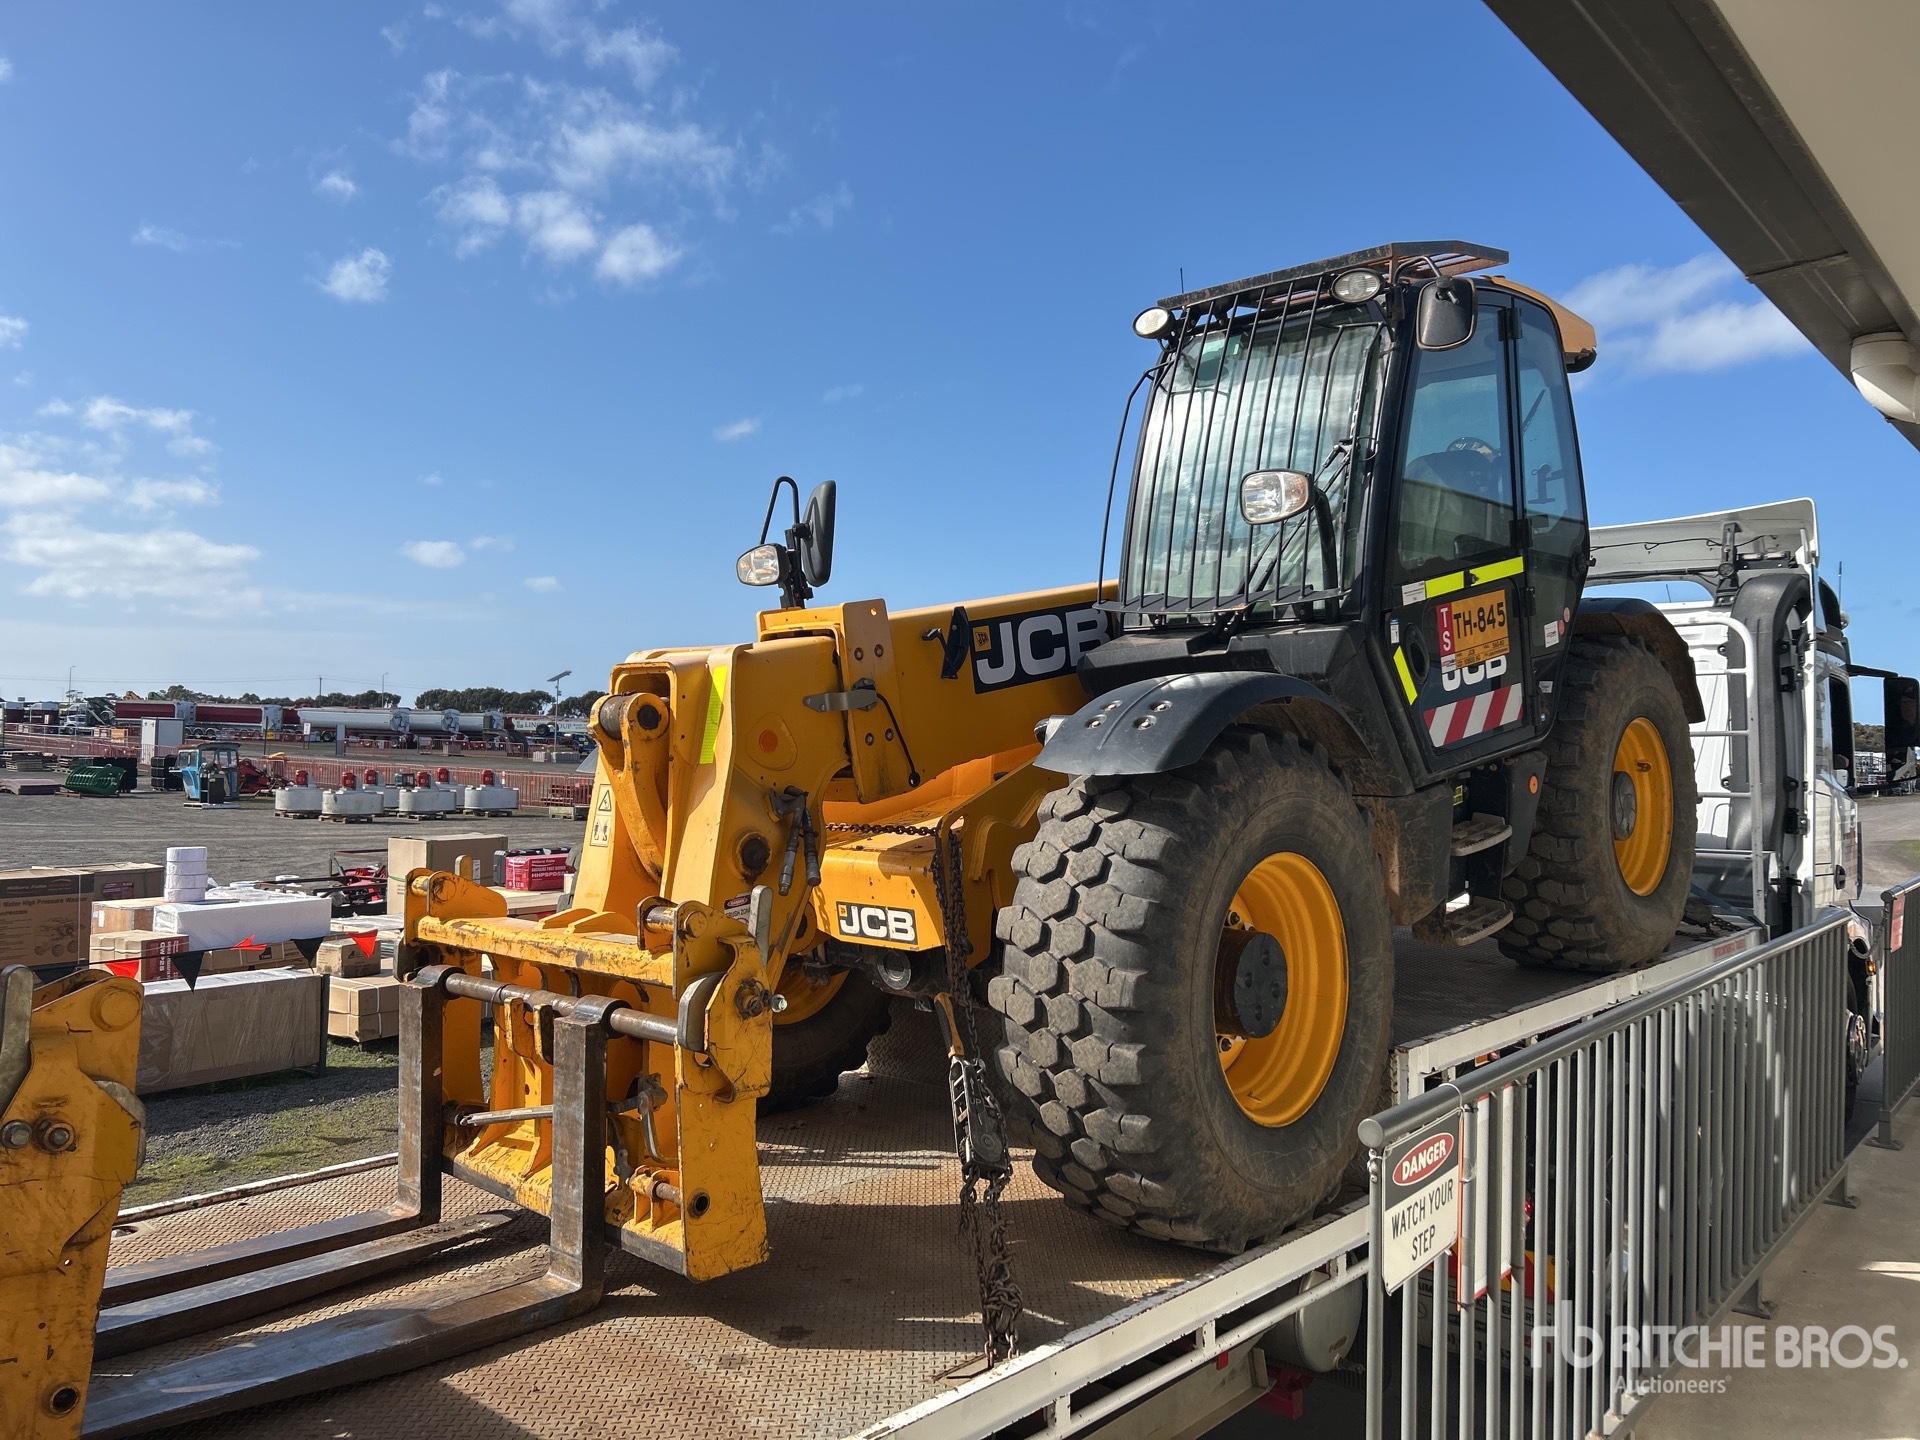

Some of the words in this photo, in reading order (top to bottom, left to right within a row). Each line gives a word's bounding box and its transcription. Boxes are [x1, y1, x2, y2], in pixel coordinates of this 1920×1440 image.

[1453, 602, 1506, 639] TH-845
[977, 608, 1110, 685] JCB
[840, 906, 916, 942] JCB
[1402, 1139, 1447, 1181] DANGER
[1391, 1196, 1426, 1240] WATCH
[1428, 1178, 1453, 1215] YOUR
[1411, 1224, 1436, 1261] STEP
